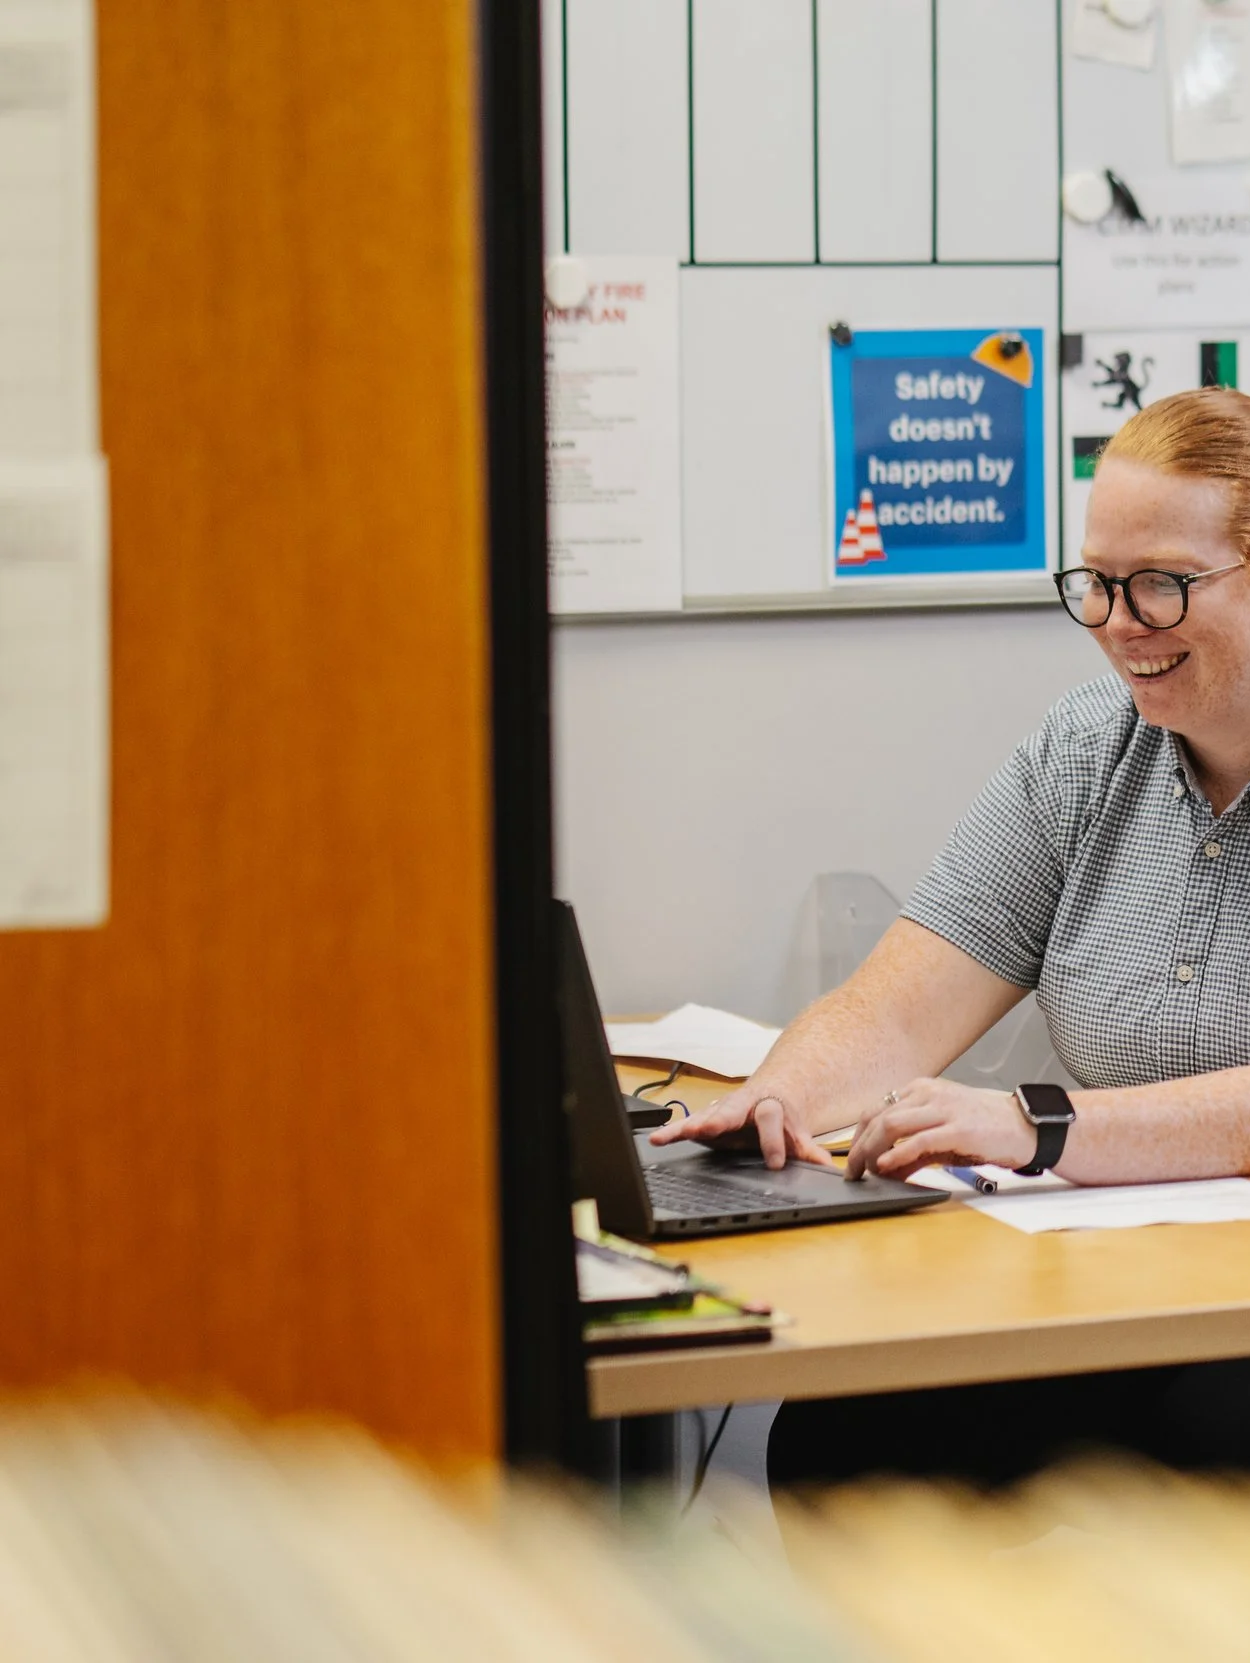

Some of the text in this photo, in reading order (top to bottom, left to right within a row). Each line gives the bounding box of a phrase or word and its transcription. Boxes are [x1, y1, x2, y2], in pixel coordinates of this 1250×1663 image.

[603, 281, 645, 300] FIRE
[574, 307, 627, 325] PLAN
[895, 370, 985, 405] Safety
[889, 411, 992, 442] doesn't
[868, 453, 1014, 489] happen by
[878, 496, 1005, 526] accident.
